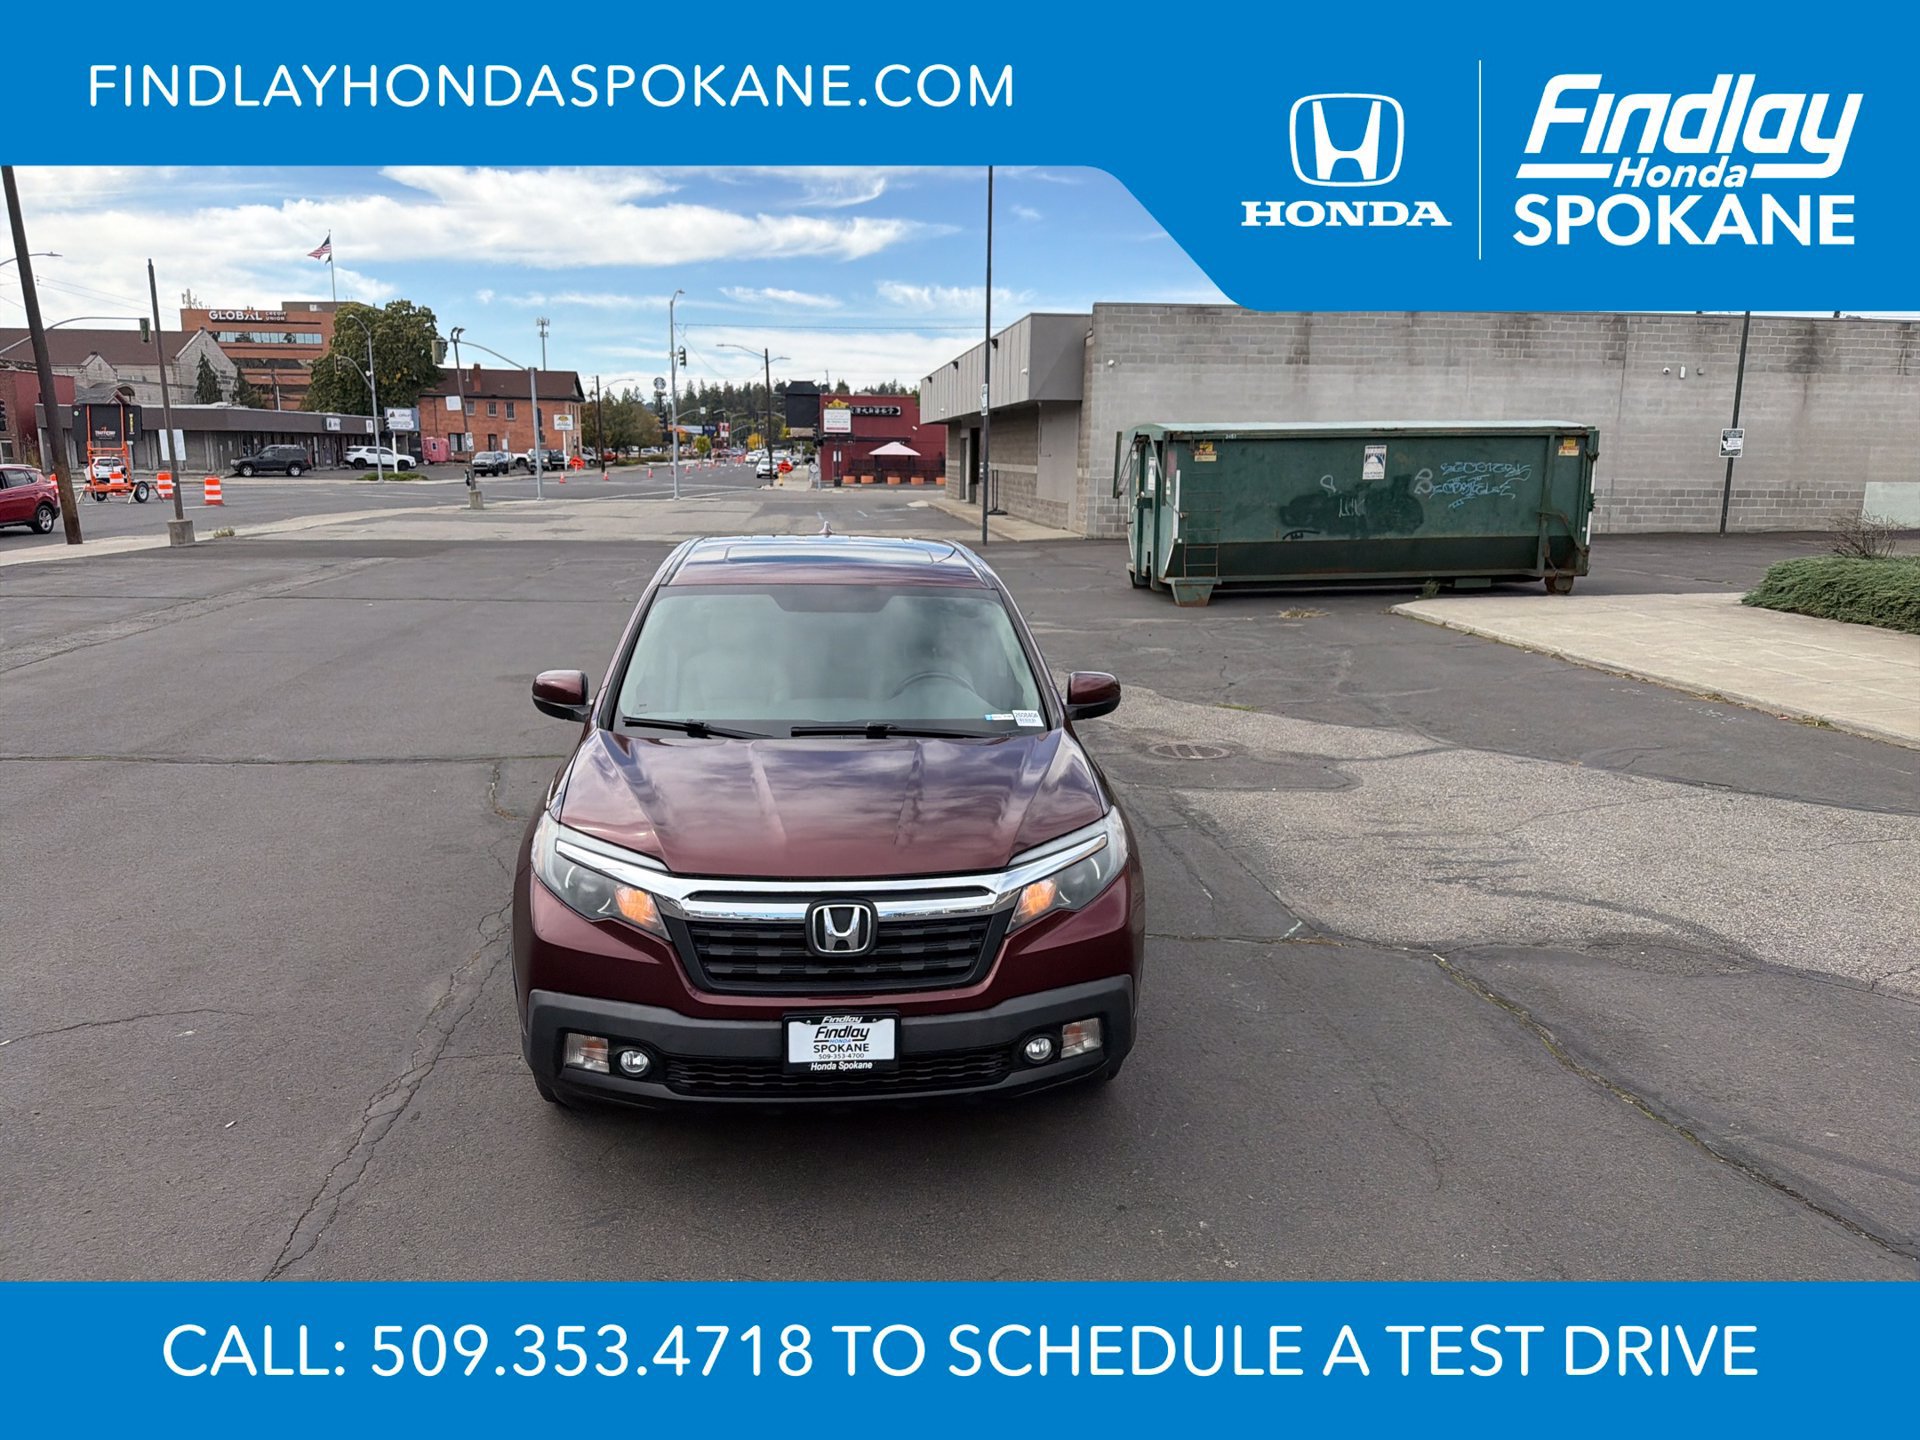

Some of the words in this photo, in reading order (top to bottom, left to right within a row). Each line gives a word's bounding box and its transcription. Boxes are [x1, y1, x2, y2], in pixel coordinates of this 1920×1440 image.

[208, 310, 263, 321] GLOBAL
[815, 1025, 870, 1041] Findlay
[813, 1043, 869, 1053] SPOKANE
[810, 1061, 837, 1071] Honda
[838, 1061, 873, 1071] Spokane
